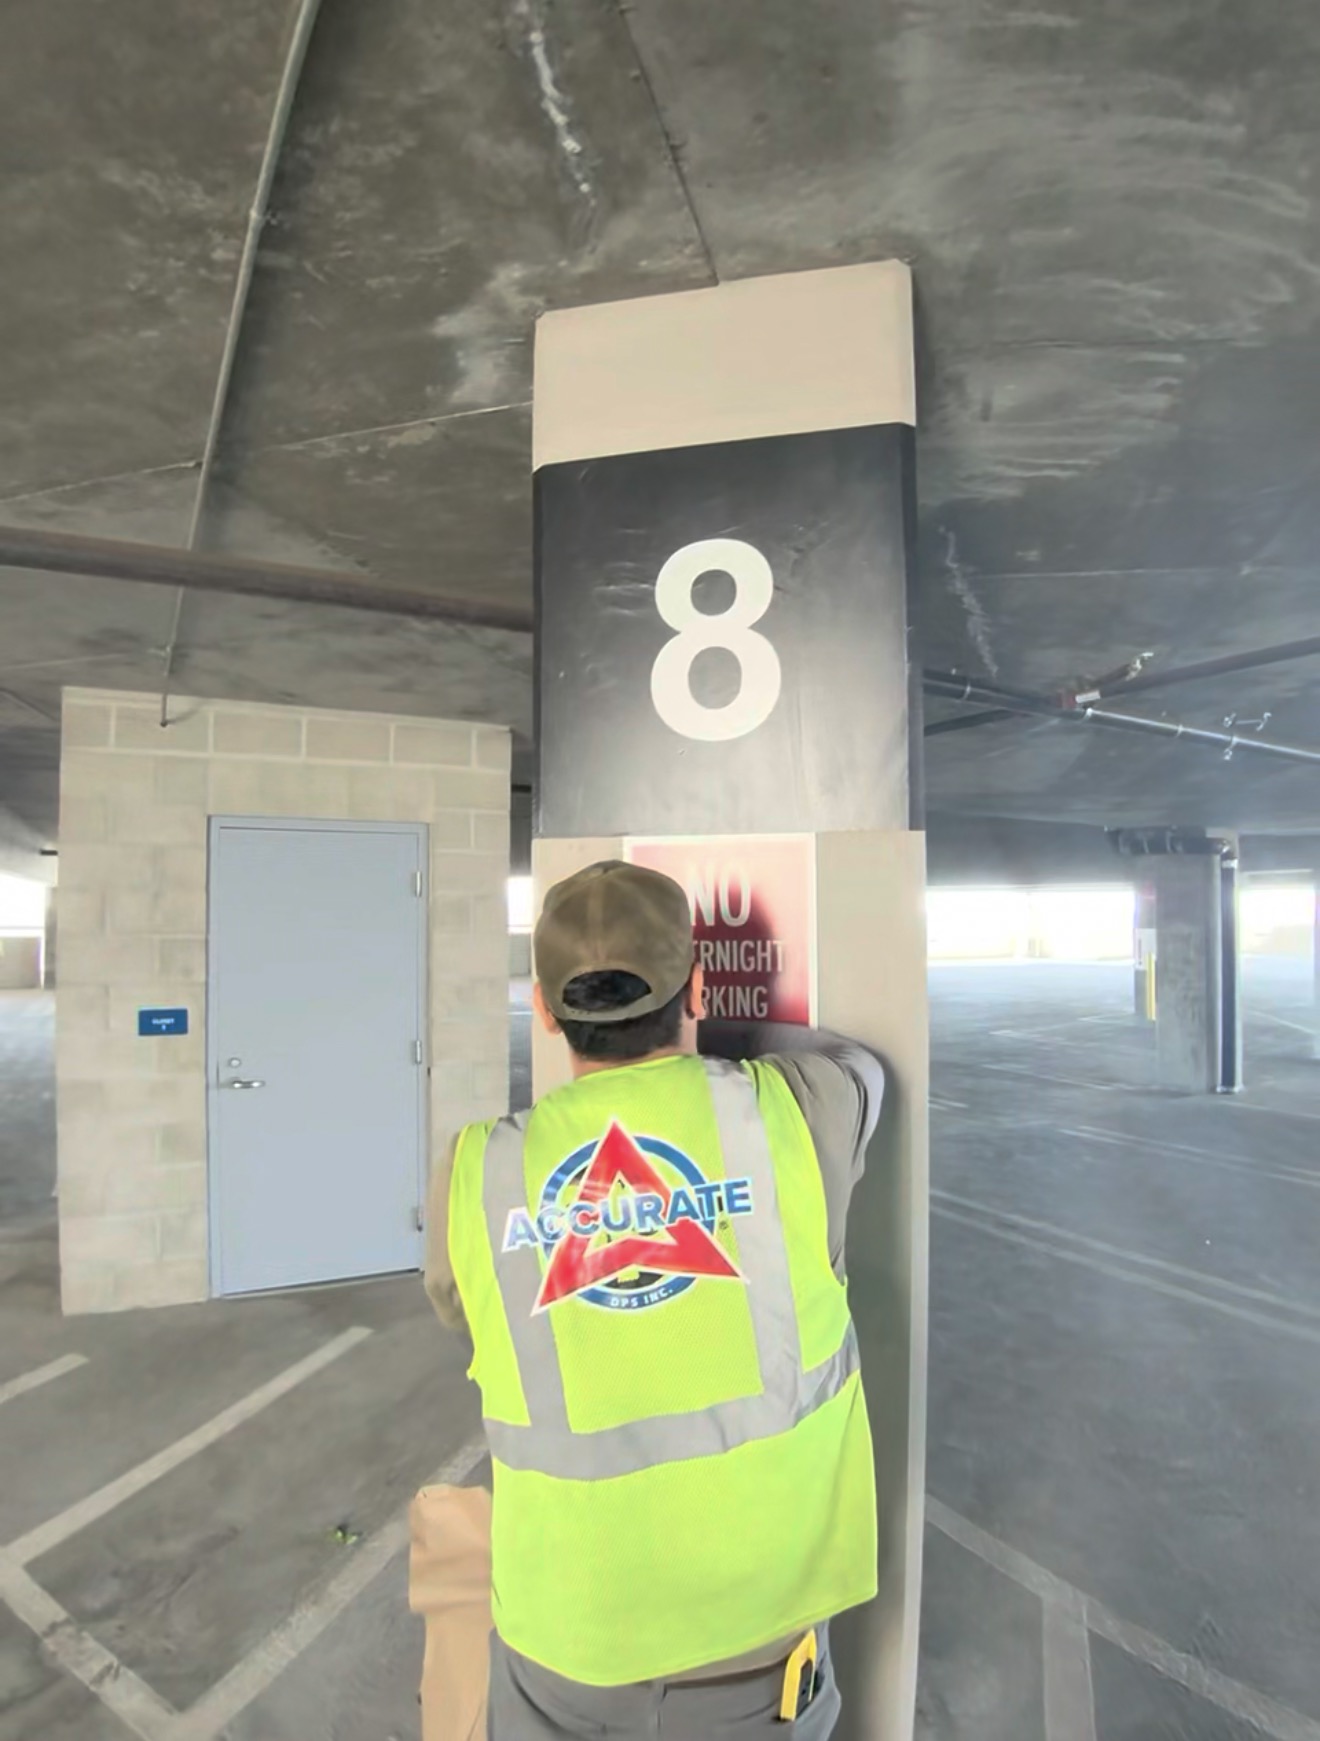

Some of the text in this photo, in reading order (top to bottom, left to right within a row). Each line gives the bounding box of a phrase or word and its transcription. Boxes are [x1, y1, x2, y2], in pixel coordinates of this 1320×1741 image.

[651, 538, 781, 741] 8
[688, 860, 751, 926] NO
[693, 940, 784, 972] RNIGHT
[701, 985, 768, 1018] RKING
[501, 1177, 753, 1252] ACCURATE
